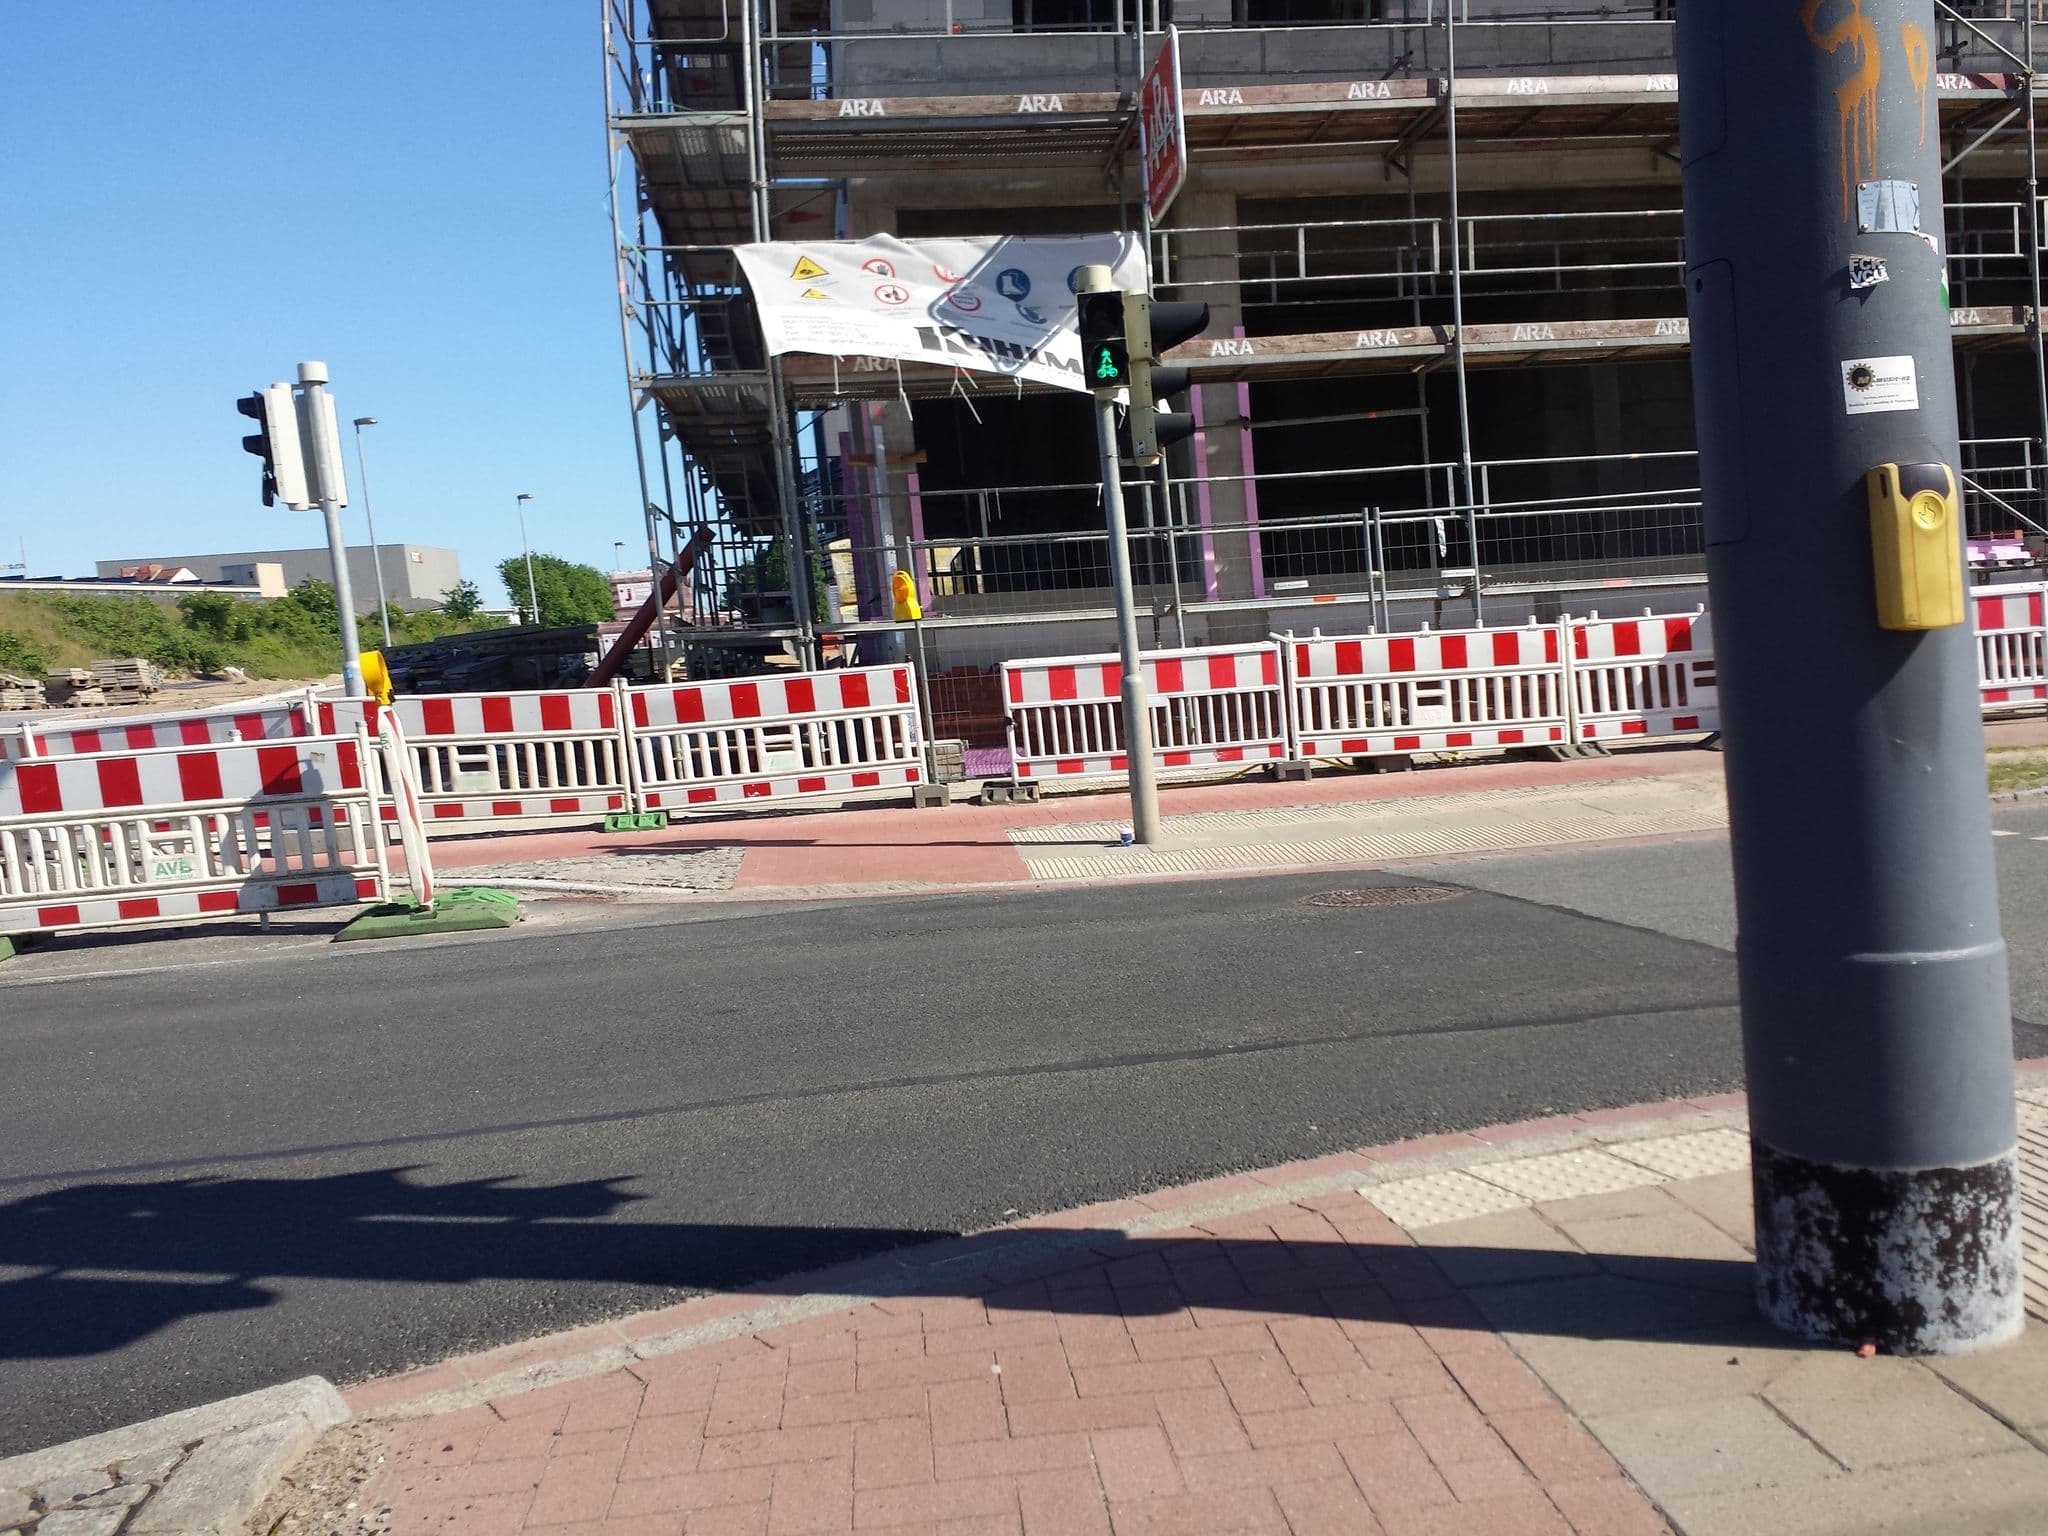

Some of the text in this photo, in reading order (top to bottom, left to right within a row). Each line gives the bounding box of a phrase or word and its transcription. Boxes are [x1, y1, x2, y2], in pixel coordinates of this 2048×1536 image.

[1347, 82, 1391, 98] ARA
[1507, 79, 1549, 95] ARA
[1646, 76, 1678, 91] AR
[1018, 95, 1064, 113] ARA
[1200, 88, 1244, 105] ARA
[839, 99, 886, 117] ARA
[1355, 331, 1400, 347] ARA
[1512, 325, 1555, 342] ARA
[1210, 339, 1255, 356] ARA
[853, 356, 897, 373] ARA
[155, 860, 193, 877] AVB
